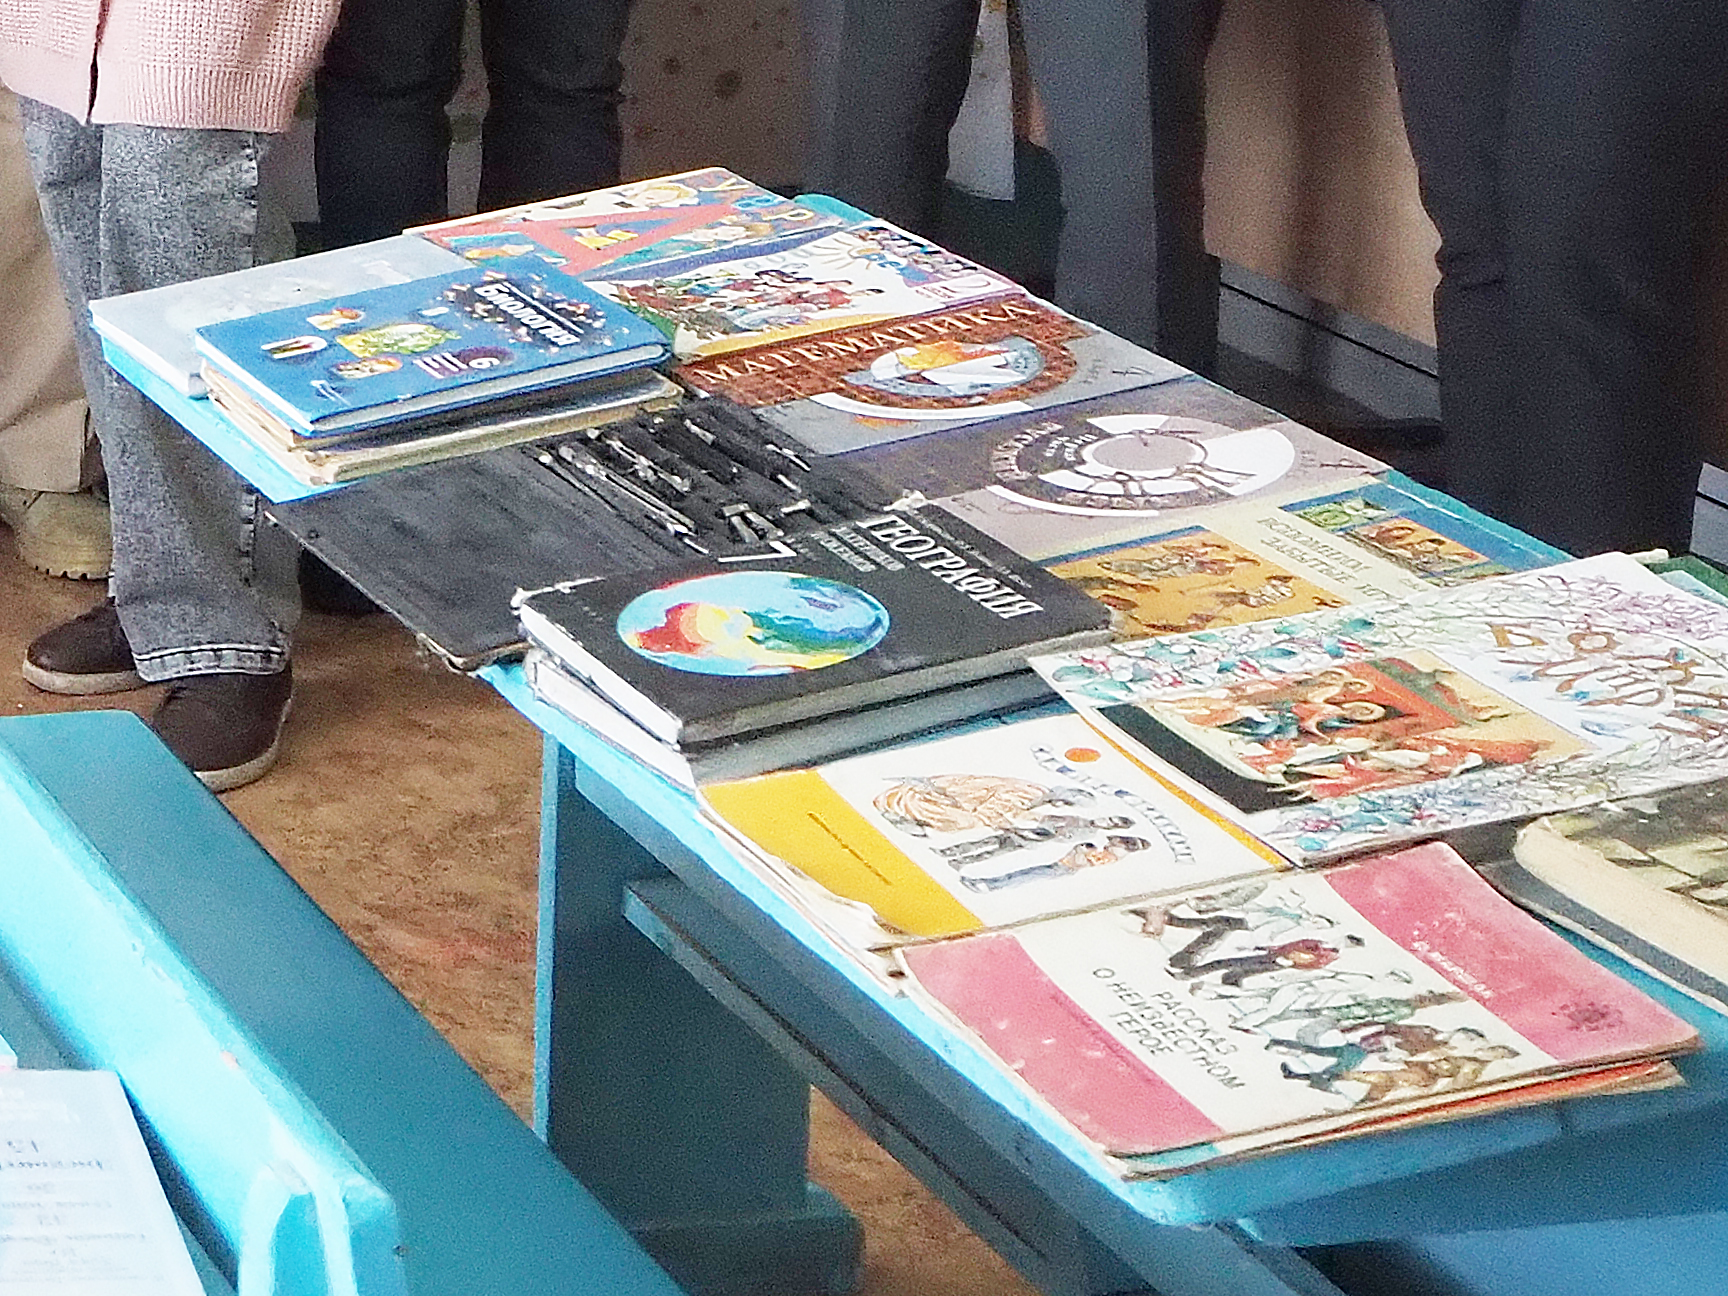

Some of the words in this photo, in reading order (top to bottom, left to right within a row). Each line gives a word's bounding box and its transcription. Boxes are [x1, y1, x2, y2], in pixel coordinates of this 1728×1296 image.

[474, 283, 582, 347] БИОЛОГИЯ
[692, 300, 1038, 385] МАТЕМАТИКА
[469, 357, 501, 369] 6
[856, 514, 1044, 620] ГЕОГРАФИЯ
[1093, 966, 1116, 980] О
[1107, 980, 1247, 1092] НЕИЗВЕСТНОМ
[1109, 1009, 1176, 1058] ГЕРОЕ
[1148, 990, 1240, 1057] РАССКАЗ
